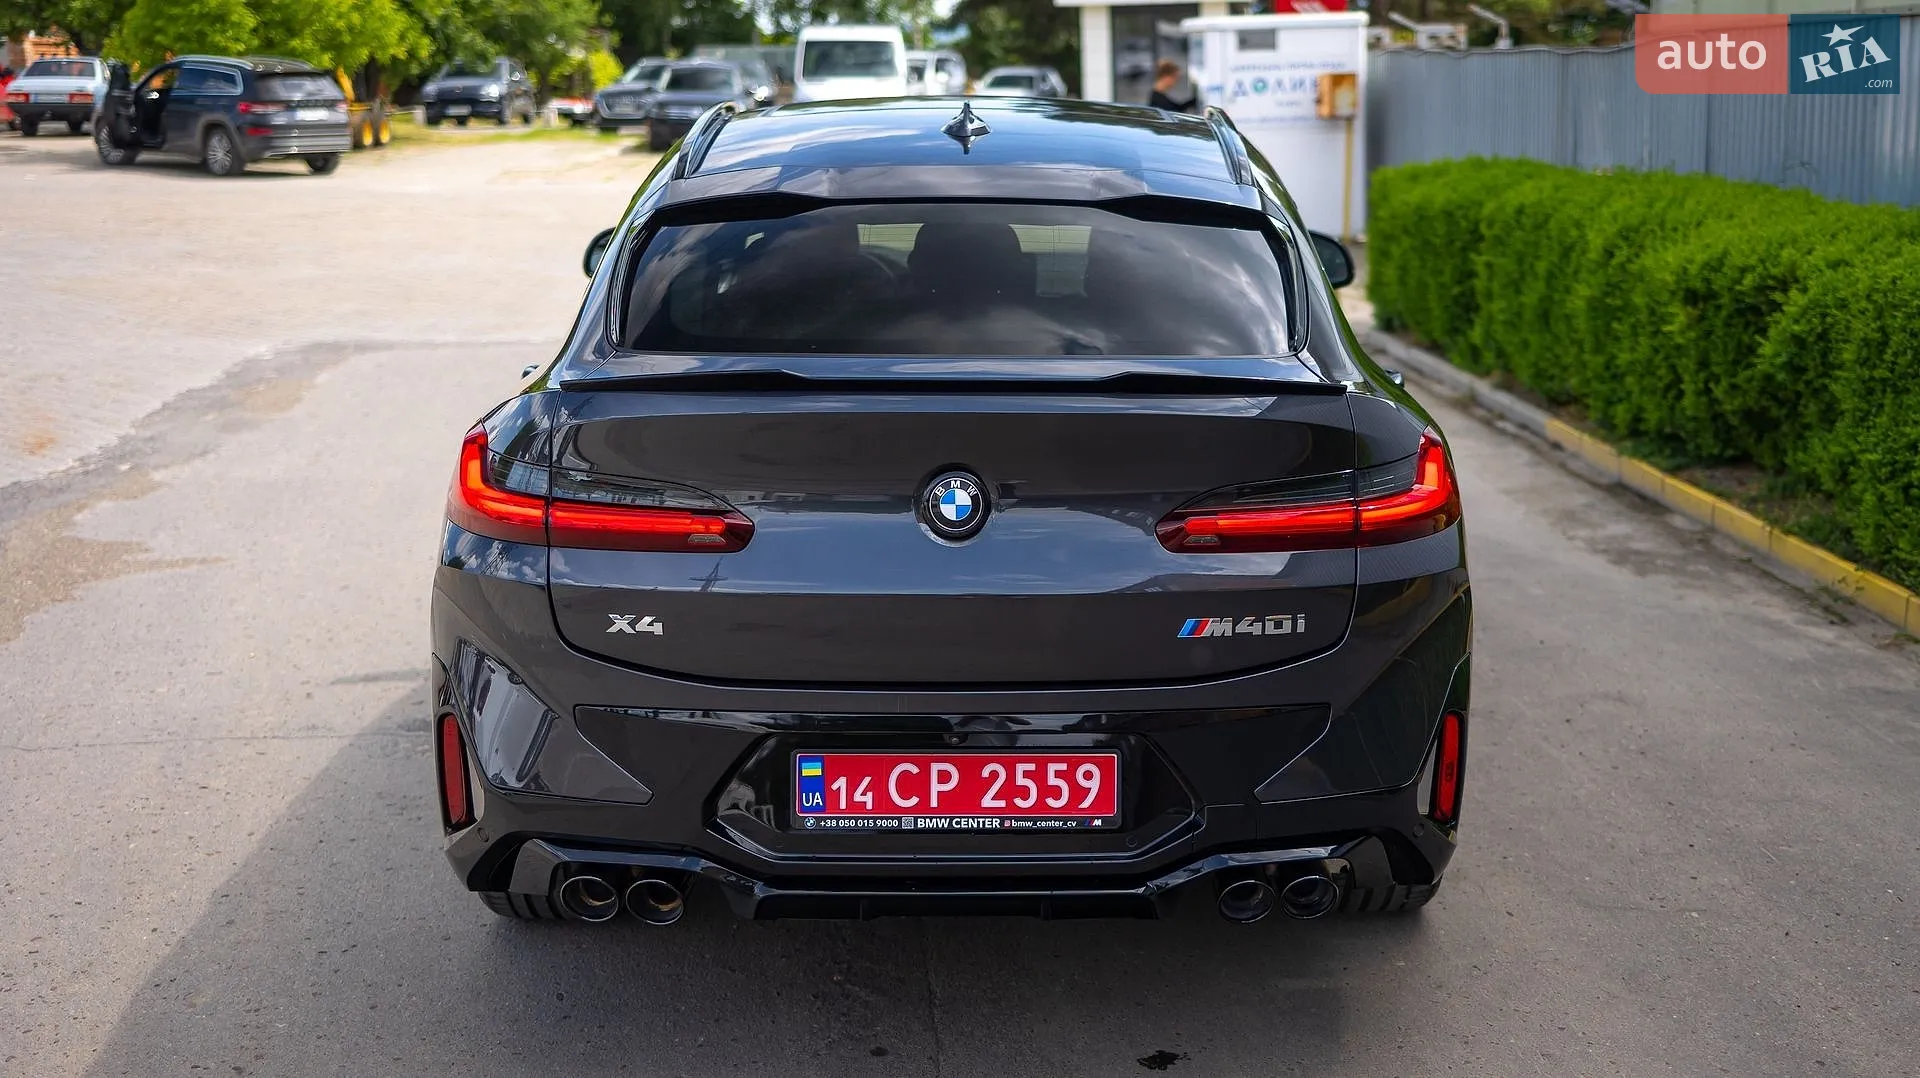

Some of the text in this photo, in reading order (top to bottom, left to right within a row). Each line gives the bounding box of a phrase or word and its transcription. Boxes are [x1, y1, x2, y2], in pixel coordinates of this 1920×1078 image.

[935, 480, 977, 497] BMW
[606, 614, 664, 635] X4
[1201, 614, 1306, 637] M40i
[830, 763, 1101, 809] 14 CP 2559
[802, 793, 823, 807] UA
[819, 819, 837, 827] +38
[839, 819, 856, 827] 050
[857, 819, 874, 827] 015
[876, 819, 899, 827] 9000
[917, 818, 949, 828] BMW
[952, 818, 1000, 828] CENTER
[1011, 819, 1077, 828] bmw_center_cv
